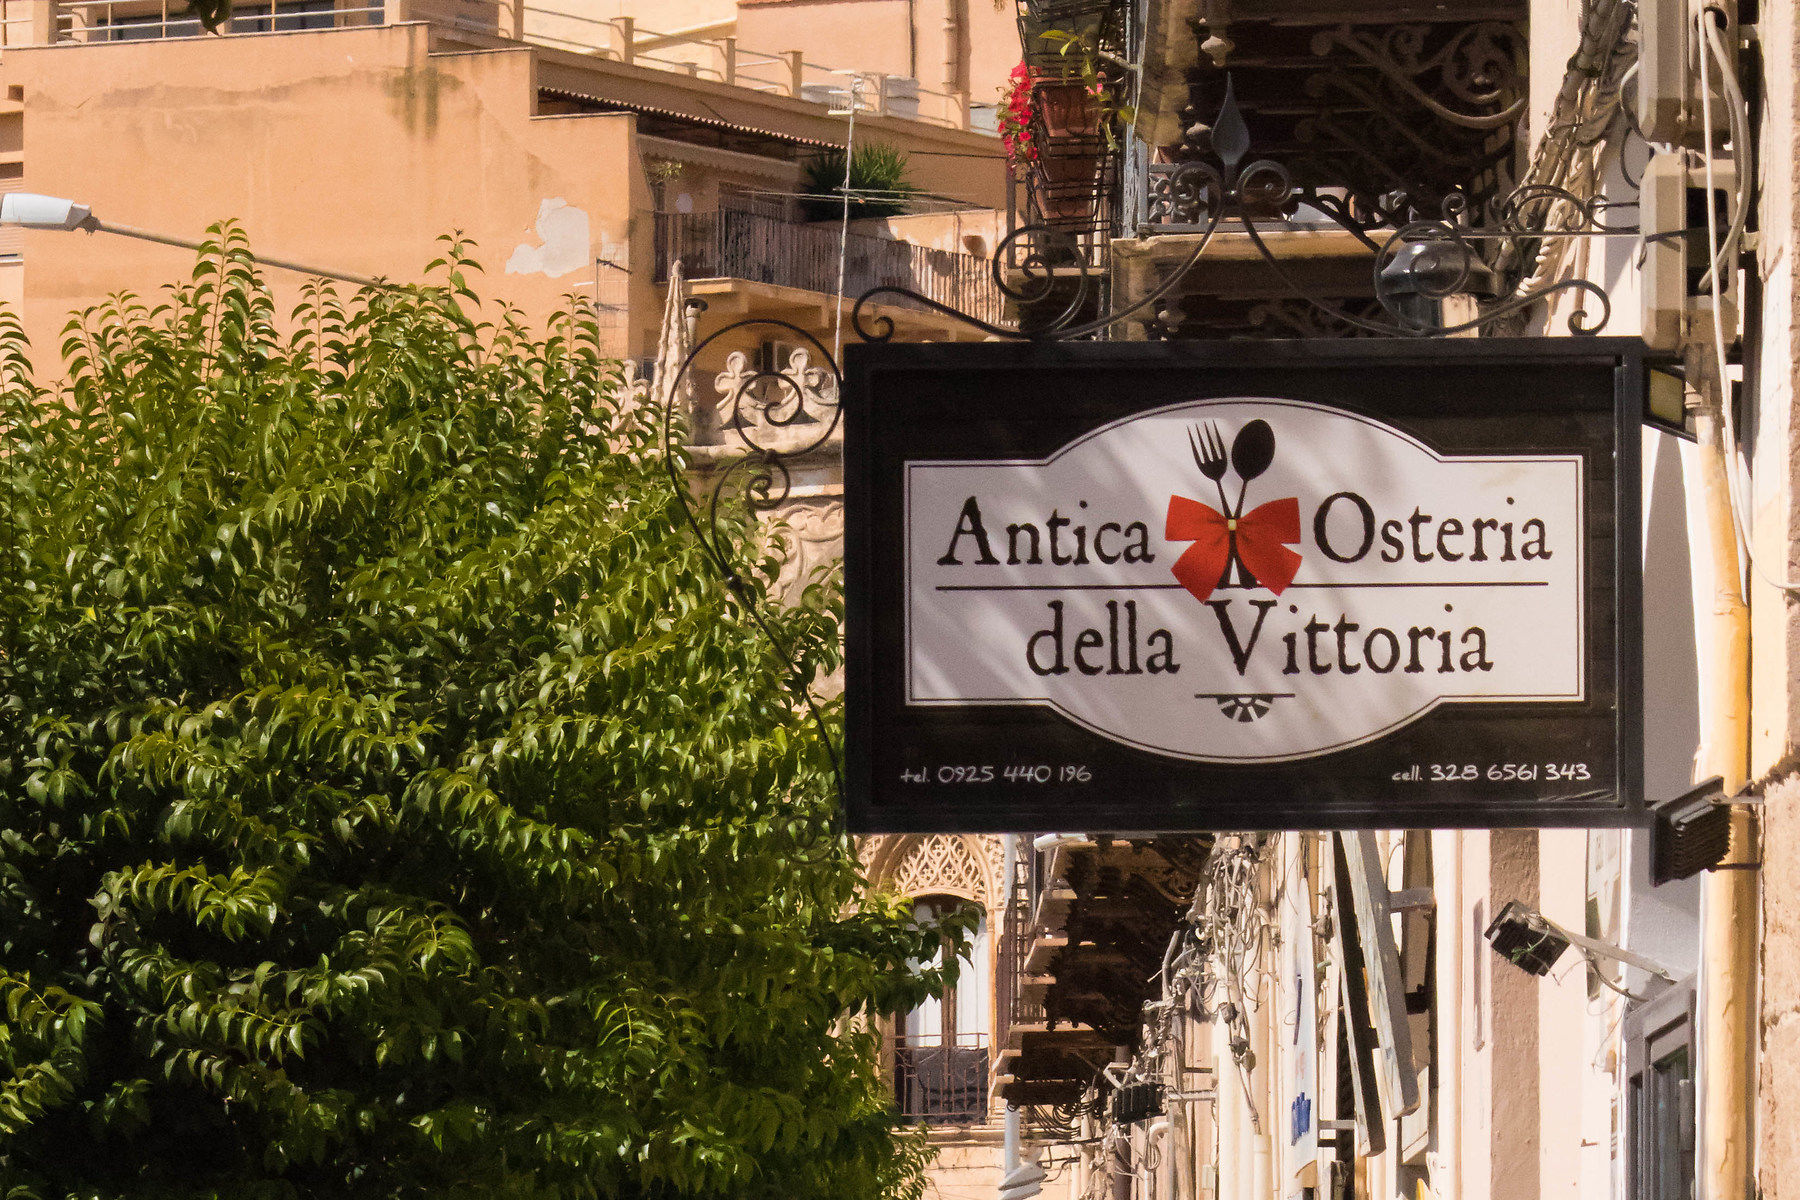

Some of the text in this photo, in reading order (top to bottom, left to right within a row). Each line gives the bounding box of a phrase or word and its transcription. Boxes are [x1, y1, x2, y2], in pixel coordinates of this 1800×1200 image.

[936, 491, 1554, 566] Antica Osteria
[1025, 599, 1495, 676] della Vittoria
[900, 765, 1093, 784] tel. 0925 440 196
[1391, 763, 1592, 782] cell. 328 6561 343
